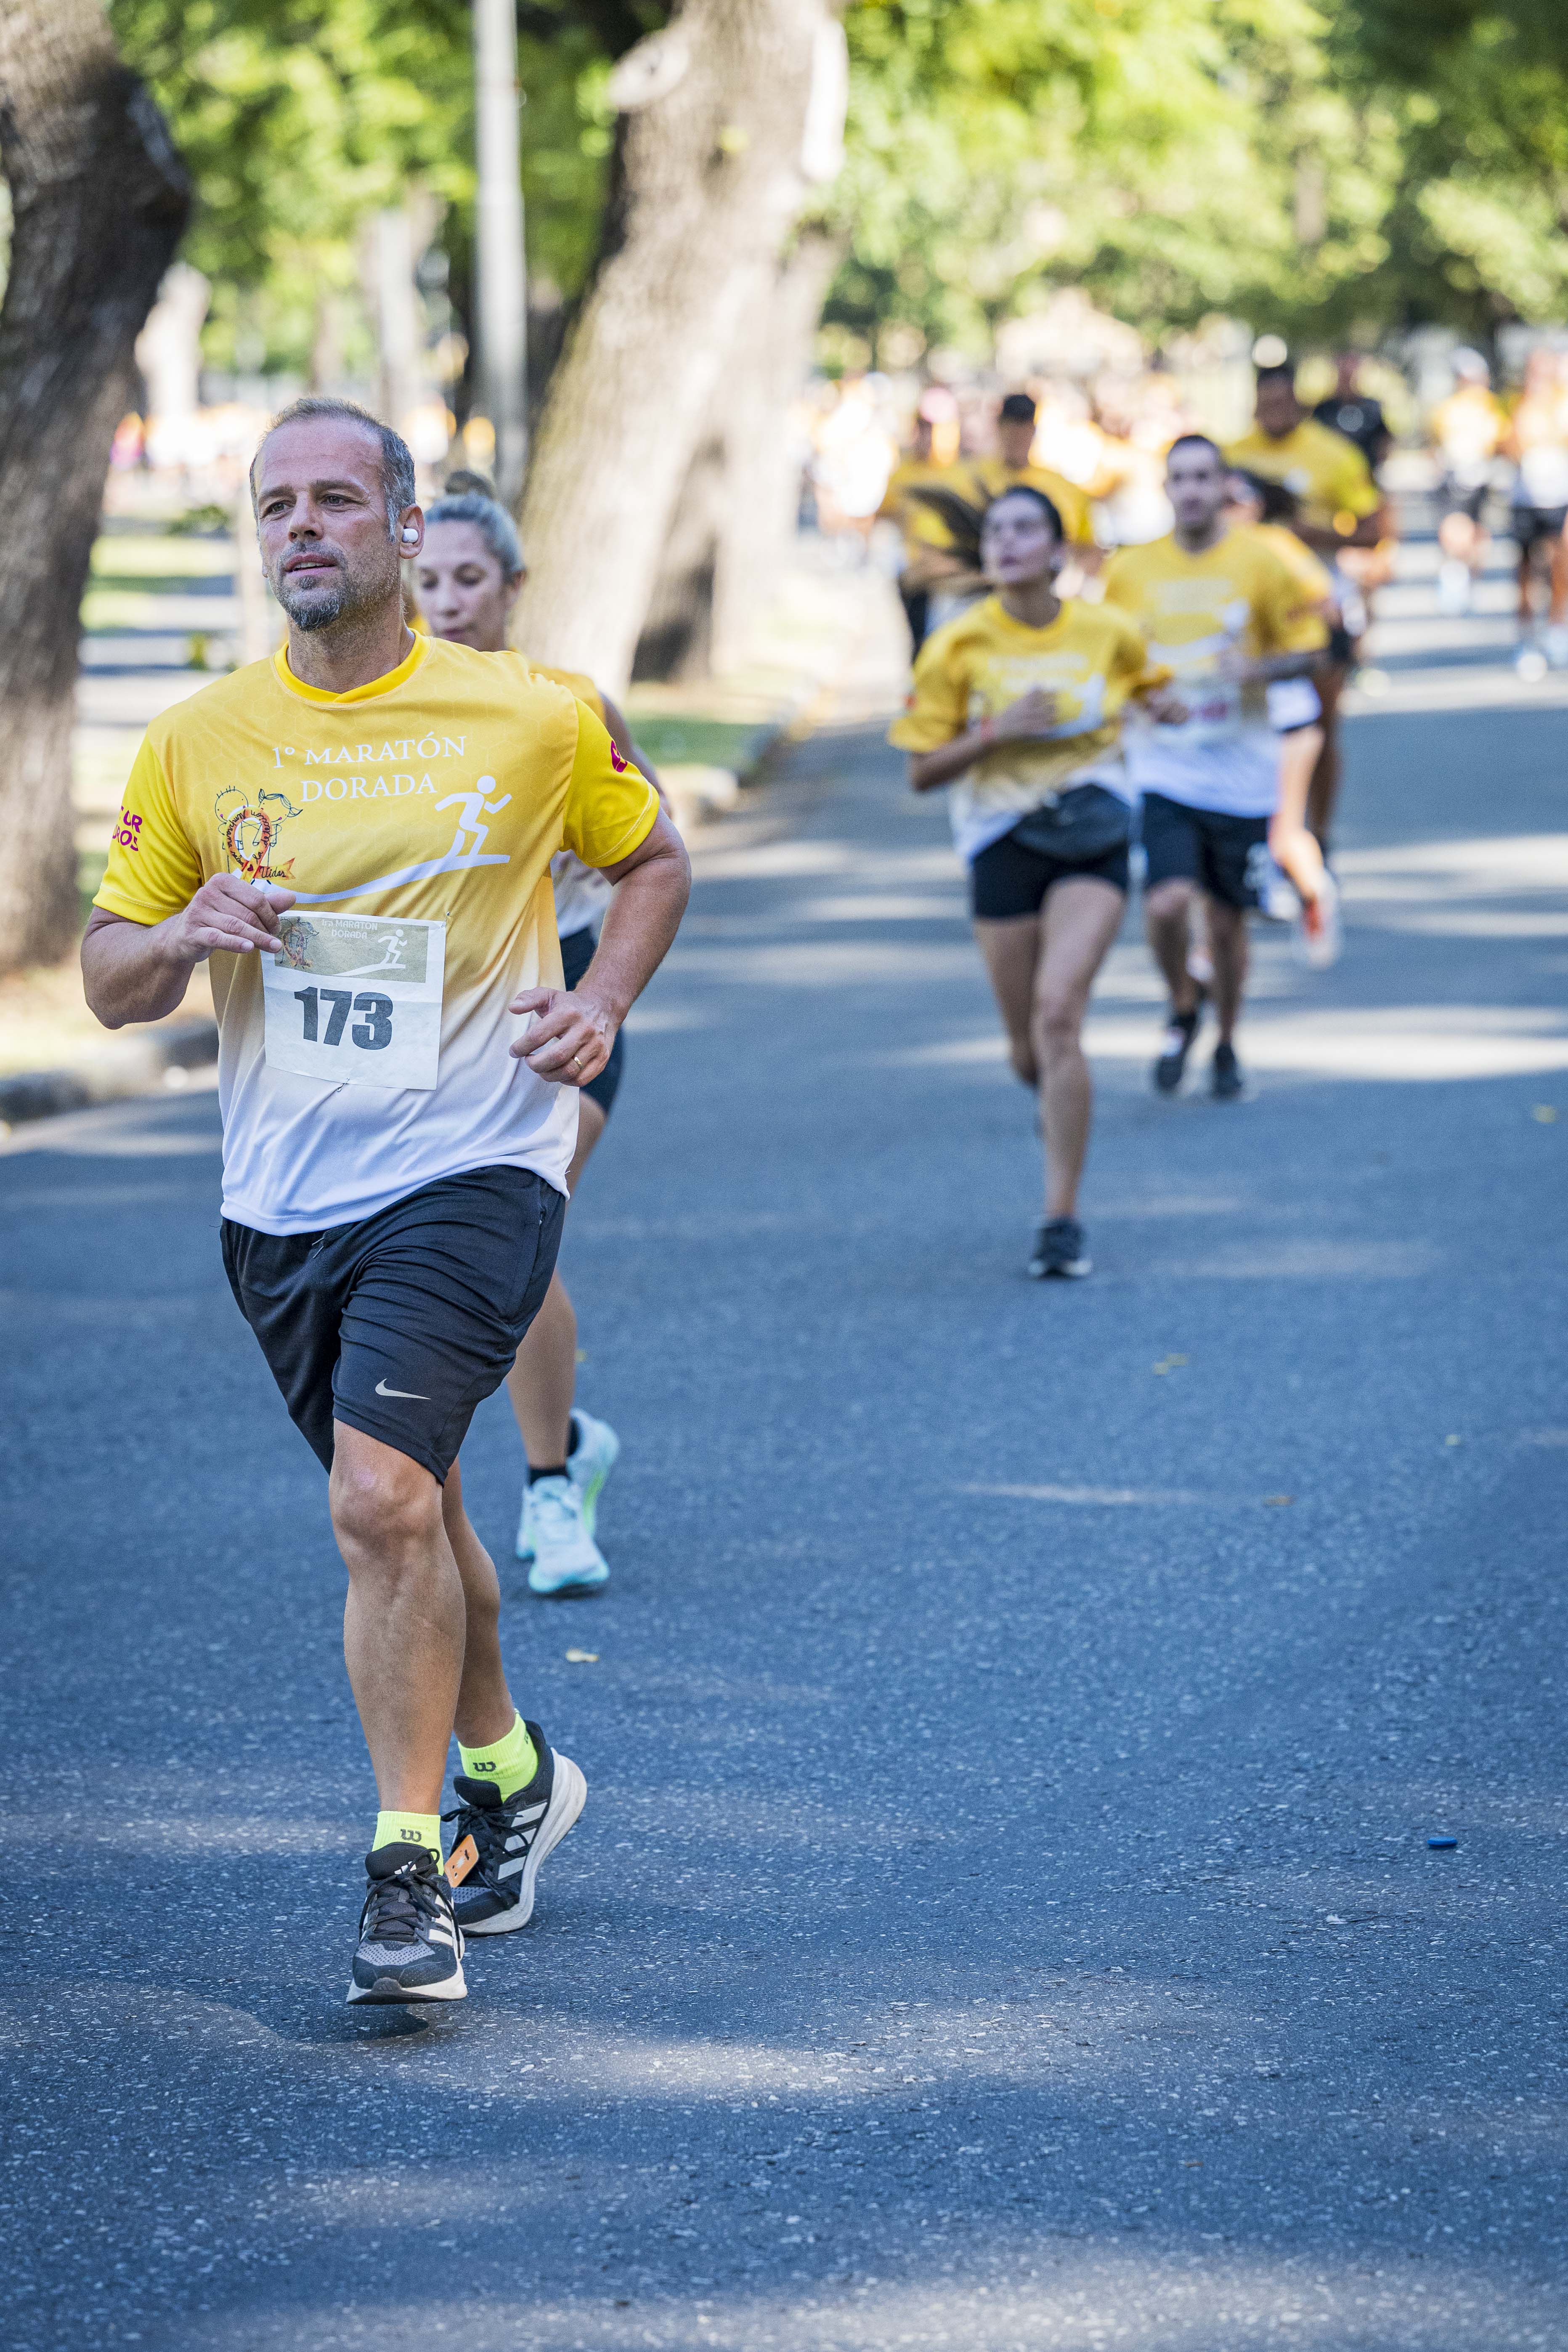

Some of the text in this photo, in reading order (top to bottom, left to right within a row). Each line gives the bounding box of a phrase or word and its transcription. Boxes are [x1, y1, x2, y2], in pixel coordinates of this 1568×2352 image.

[304, 732, 467, 765] MARATÓN
[300, 773, 438, 802] DORADA
[332, 929, 367, 940] DORADA
[294, 986, 393, 1050] 173
